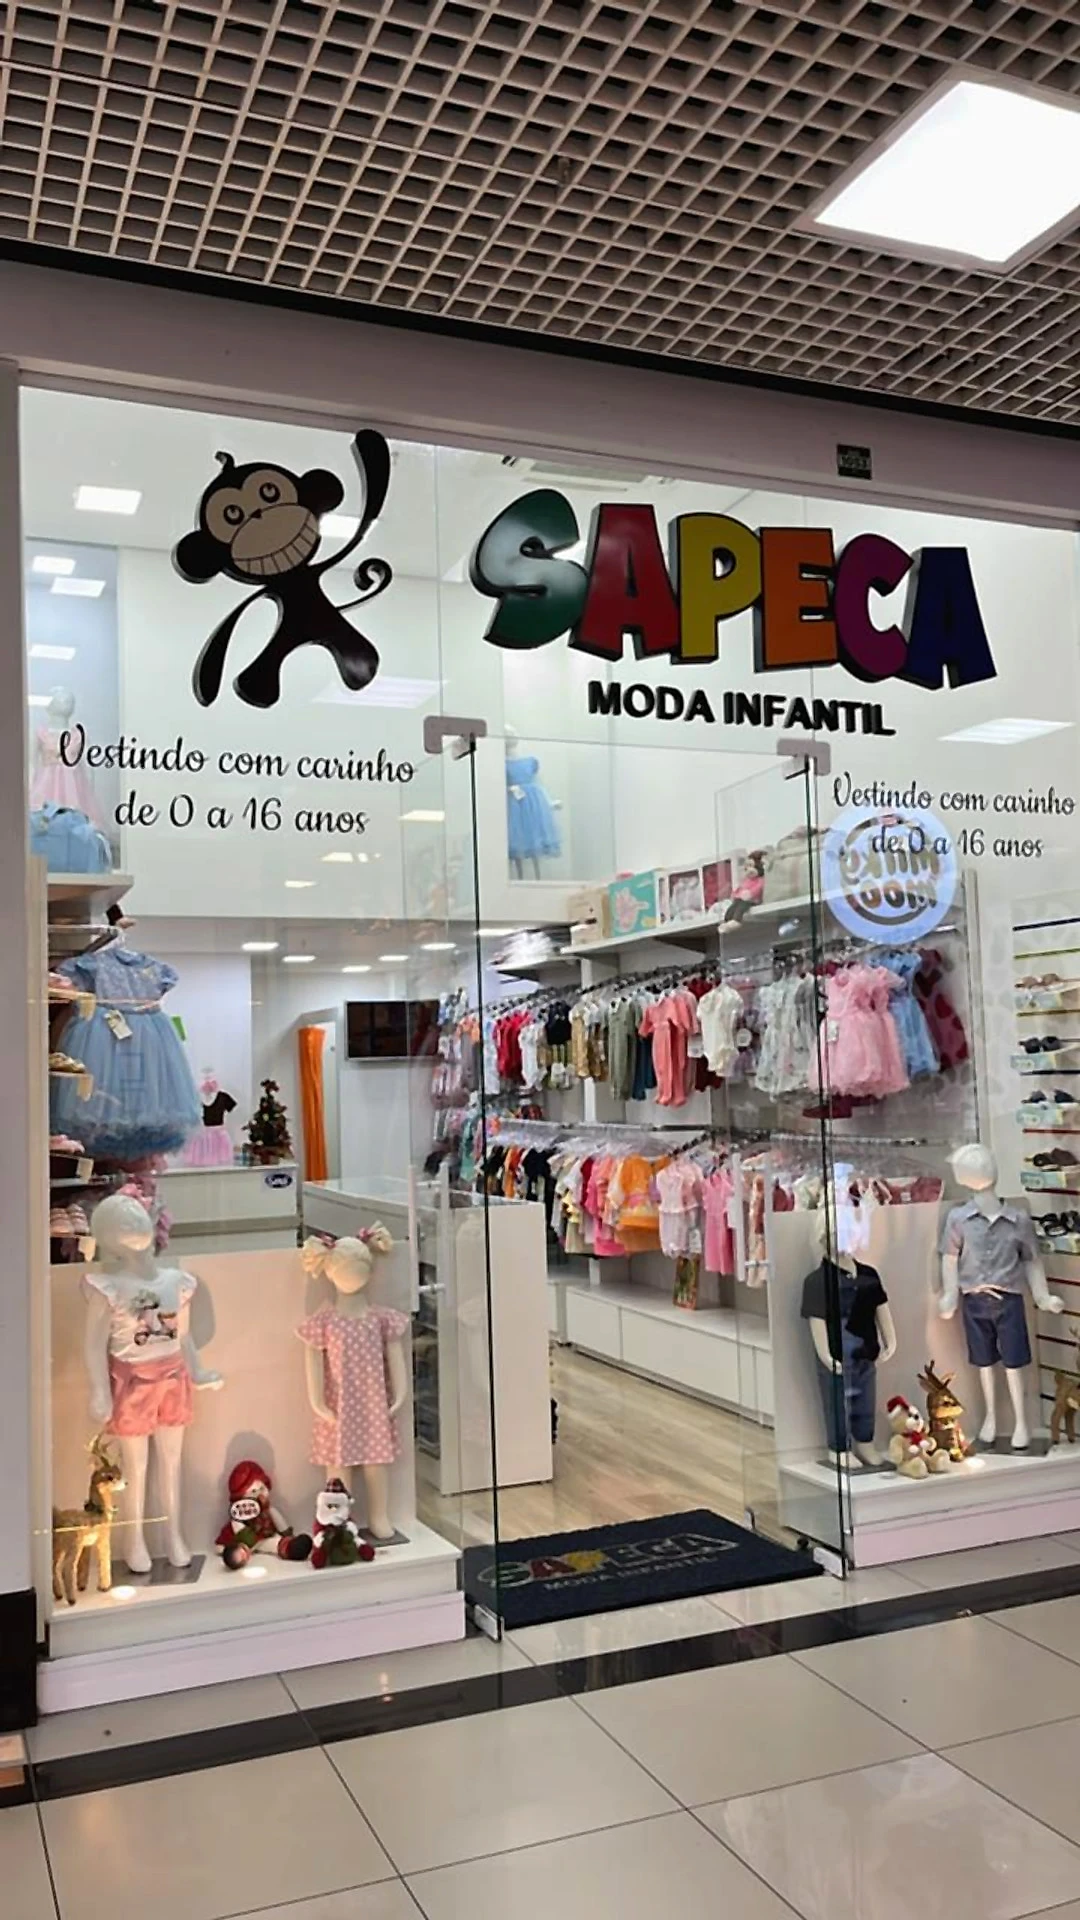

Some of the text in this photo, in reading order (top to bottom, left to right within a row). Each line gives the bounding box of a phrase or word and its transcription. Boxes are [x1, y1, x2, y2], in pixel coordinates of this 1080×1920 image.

[469, 487, 998, 691] SAPECA
[588, 680, 896, 736] MODA INFANTIL
[59, 723, 416, 783] Vestindo com carinho
[114, 790, 159, 827] de
[207, 806, 234, 830] a
[242, 796, 282, 831] 16
[295, 809, 370, 834] anos
[833, 771, 1076, 815] Vestindo com carinho
[872, 824, 903, 854] de
[933, 836, 949, 855] a
[957, 828, 985, 856] 16
[993, 837, 1045, 858] anos
